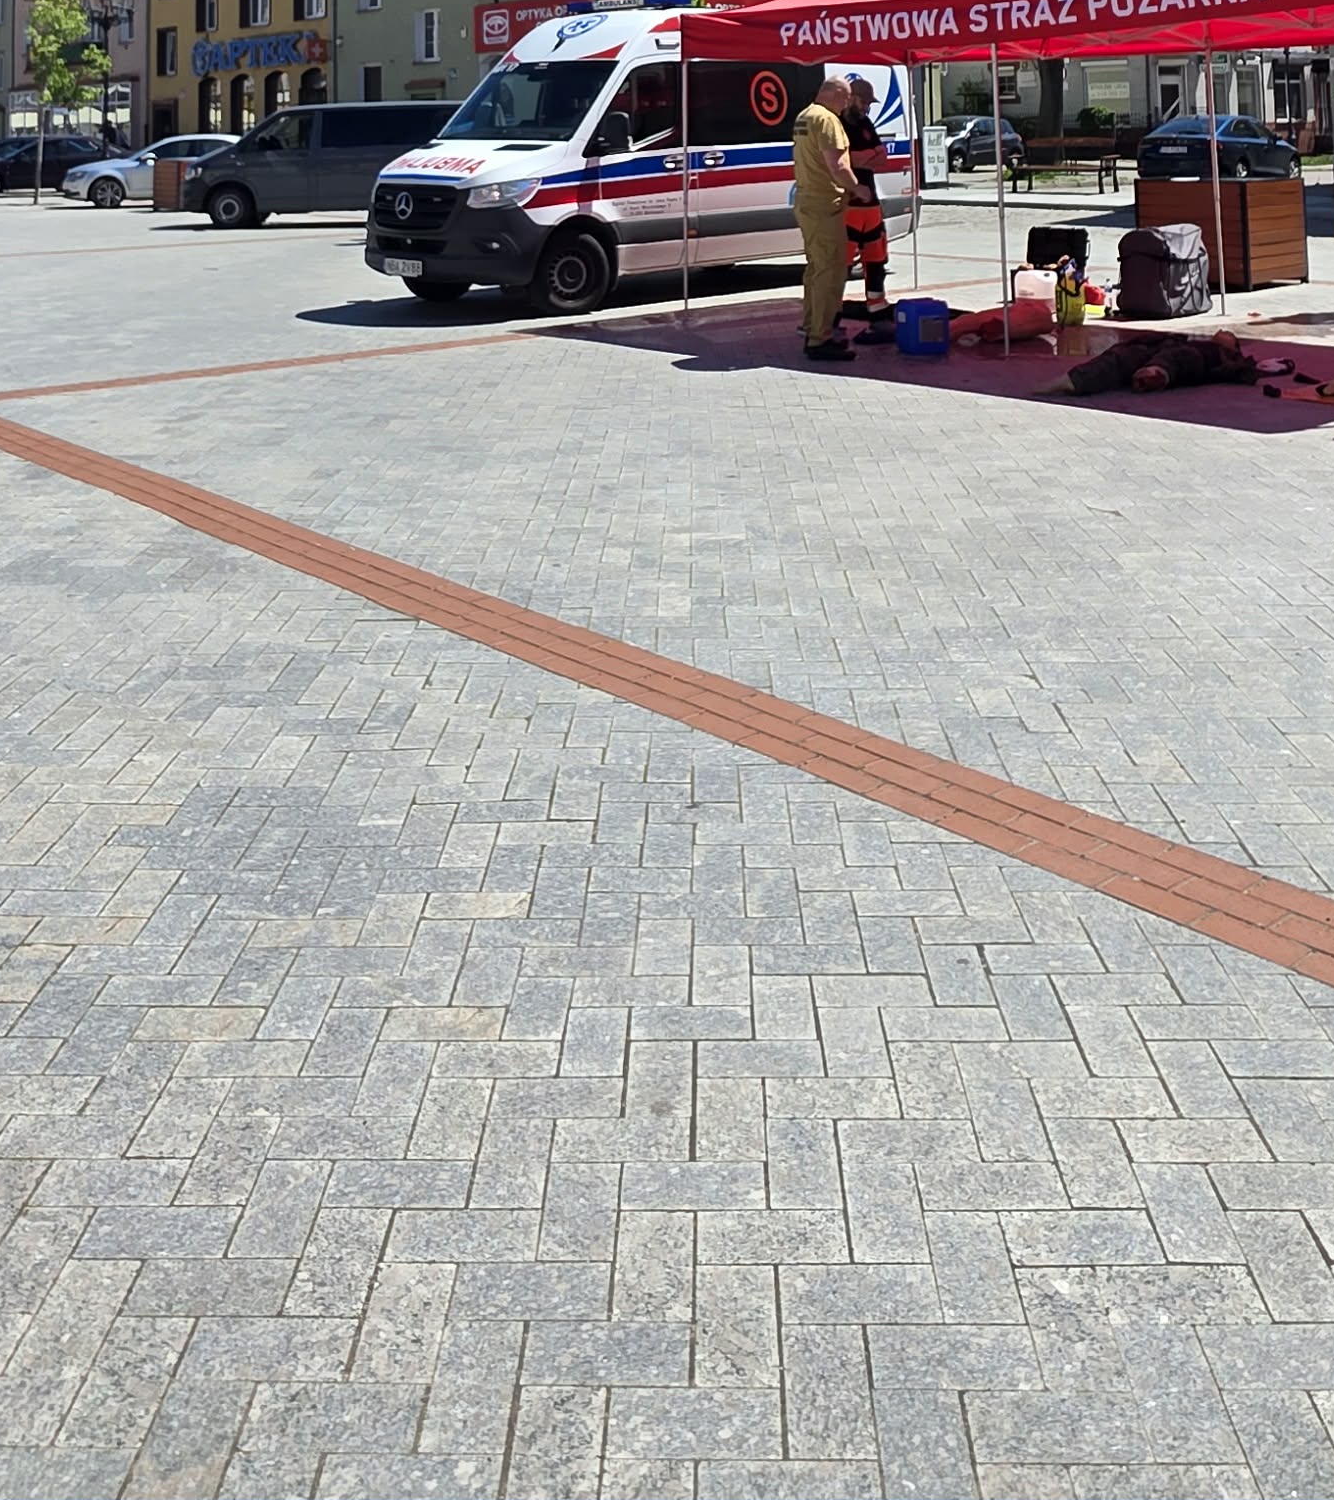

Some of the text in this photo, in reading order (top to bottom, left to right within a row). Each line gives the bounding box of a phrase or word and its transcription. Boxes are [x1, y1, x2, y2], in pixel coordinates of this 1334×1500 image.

[515, 8, 553, 21] OPTYKA
[780, 7, 959, 46] PAŃSTWOWA
[761, 82, 779, 113] S
[886, 142, 896, 153] 17
